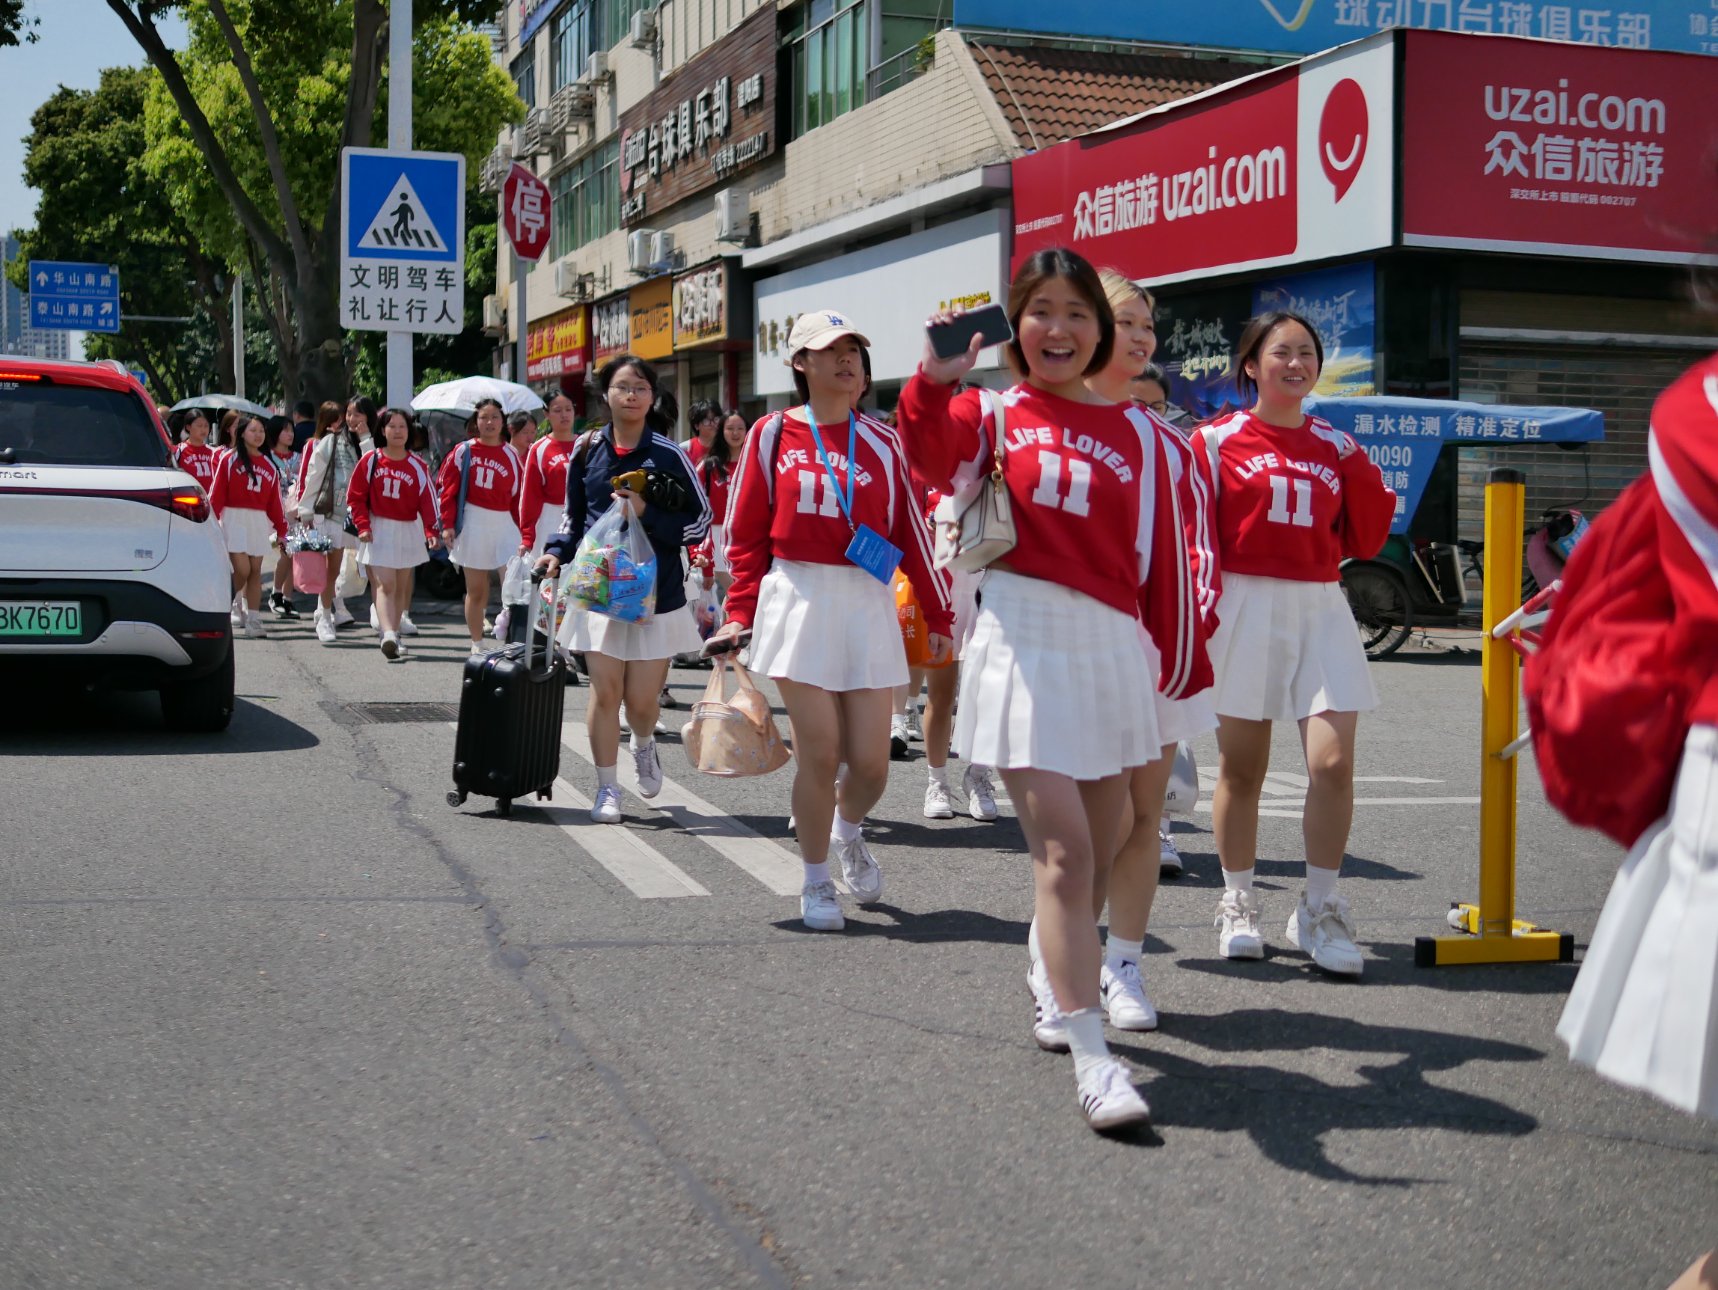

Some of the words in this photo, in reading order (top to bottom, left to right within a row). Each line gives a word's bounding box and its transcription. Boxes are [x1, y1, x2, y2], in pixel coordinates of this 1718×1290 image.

[1484, 78, 1666, 134] uzai.com
[1484, 130, 1665, 188] 众信旅游
[511, 179, 546, 244] 停
[1073, 172, 1159, 242] 众信旅游
[1162, 146, 1286, 222] uzai.com
[349, 264, 457, 292] 文明驾车
[349, 296, 456, 324] 礼让行人
[1354, 414, 1441, 437] 漏水检测
[1456, 415, 1542, 439] 精准定位
[475, 466, 495, 490] 11
[484, 458, 509, 478] LOVER
[776, 449, 809, 475] LIFE
[815, 450, 873, 487] LOVER
[1005, 426, 1054, 452] LIFE
[1062, 427, 1134, 484] LOVER
[1235, 452, 1279, 480] LIFE
[1286, 457, 1340, 496] LOVER
[382, 477, 401, 500] 11
[796, 470, 840, 518] 11
[1032, 450, 1092, 518] 11
[1267, 475, 1314, 528] 11
